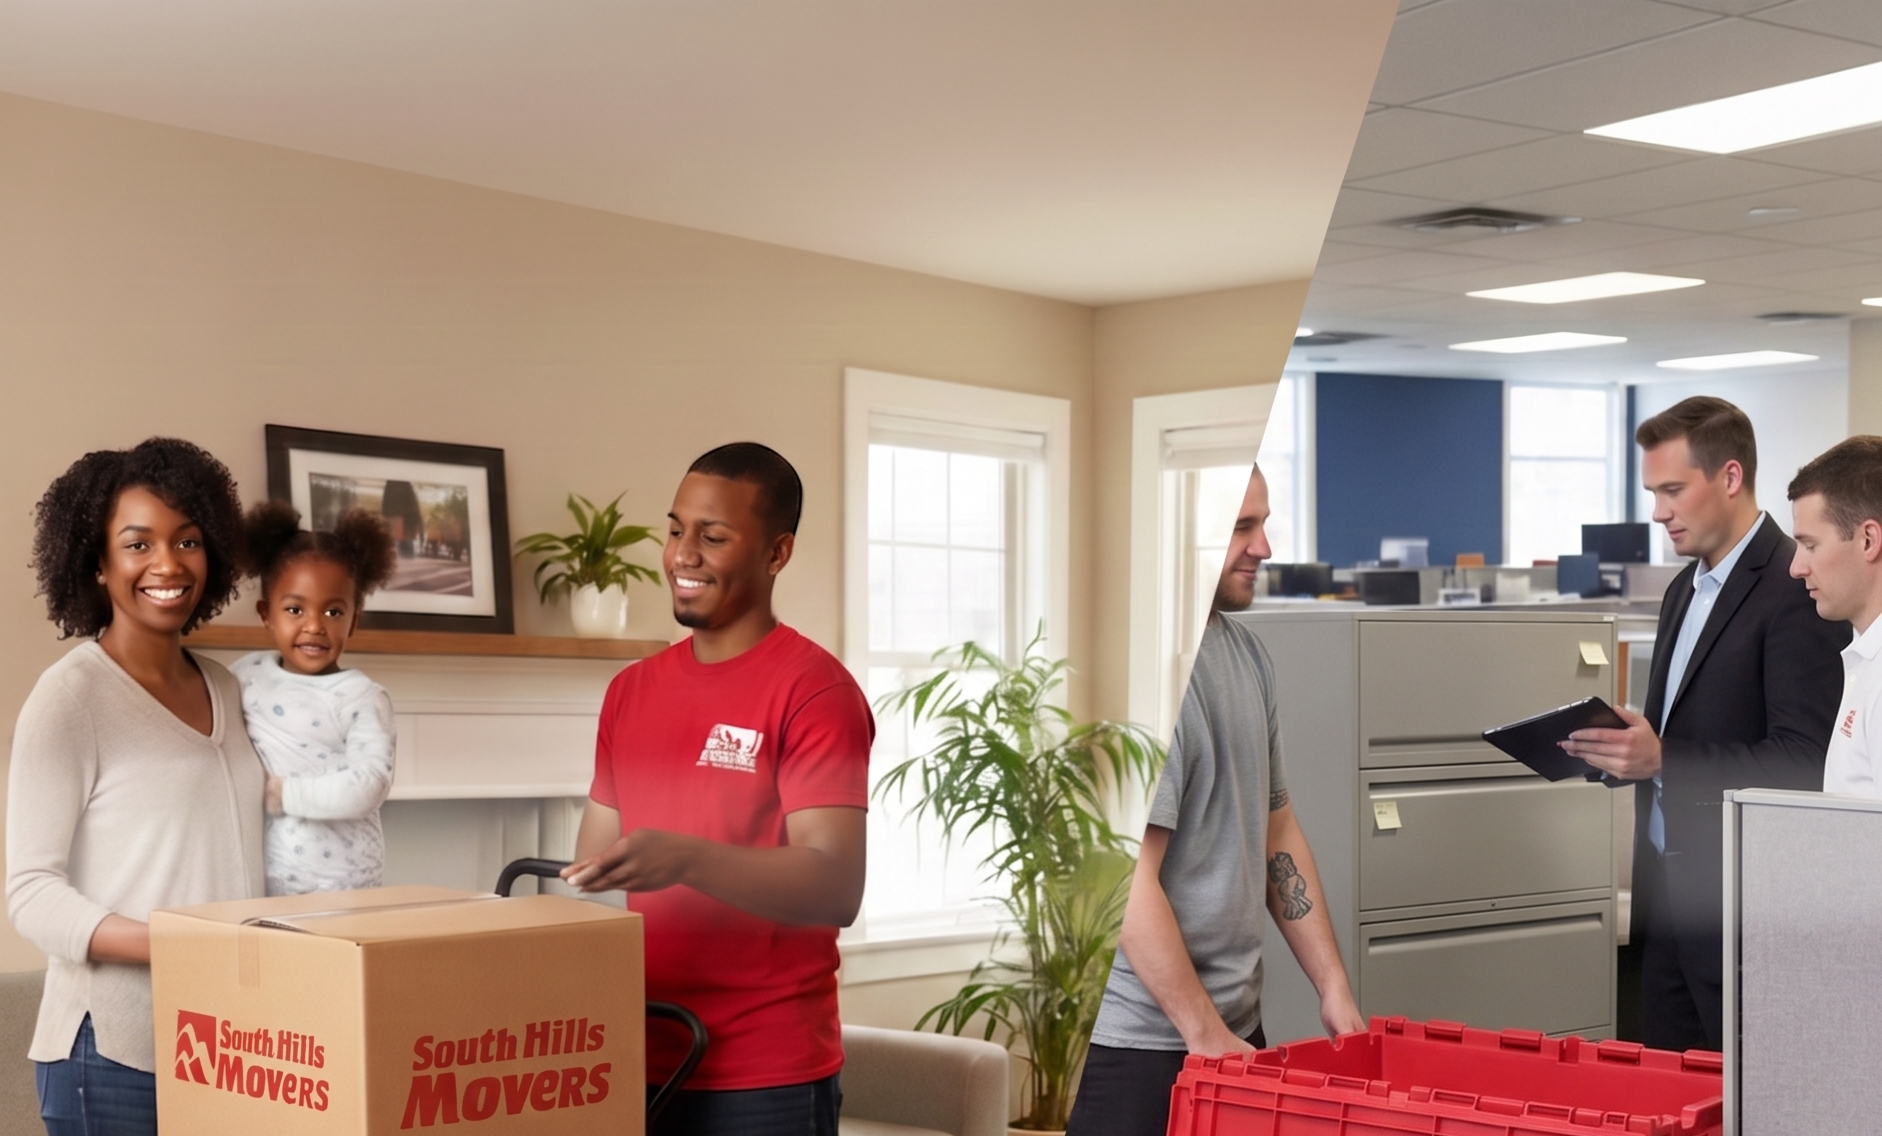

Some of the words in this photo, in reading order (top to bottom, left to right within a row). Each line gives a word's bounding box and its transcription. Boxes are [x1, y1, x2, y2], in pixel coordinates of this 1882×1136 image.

[220, 1020, 273, 1057] South
[277, 1030, 324, 1068] Hills
[413, 1028, 517, 1071] South
[523, 1018, 604, 1058] Hills
